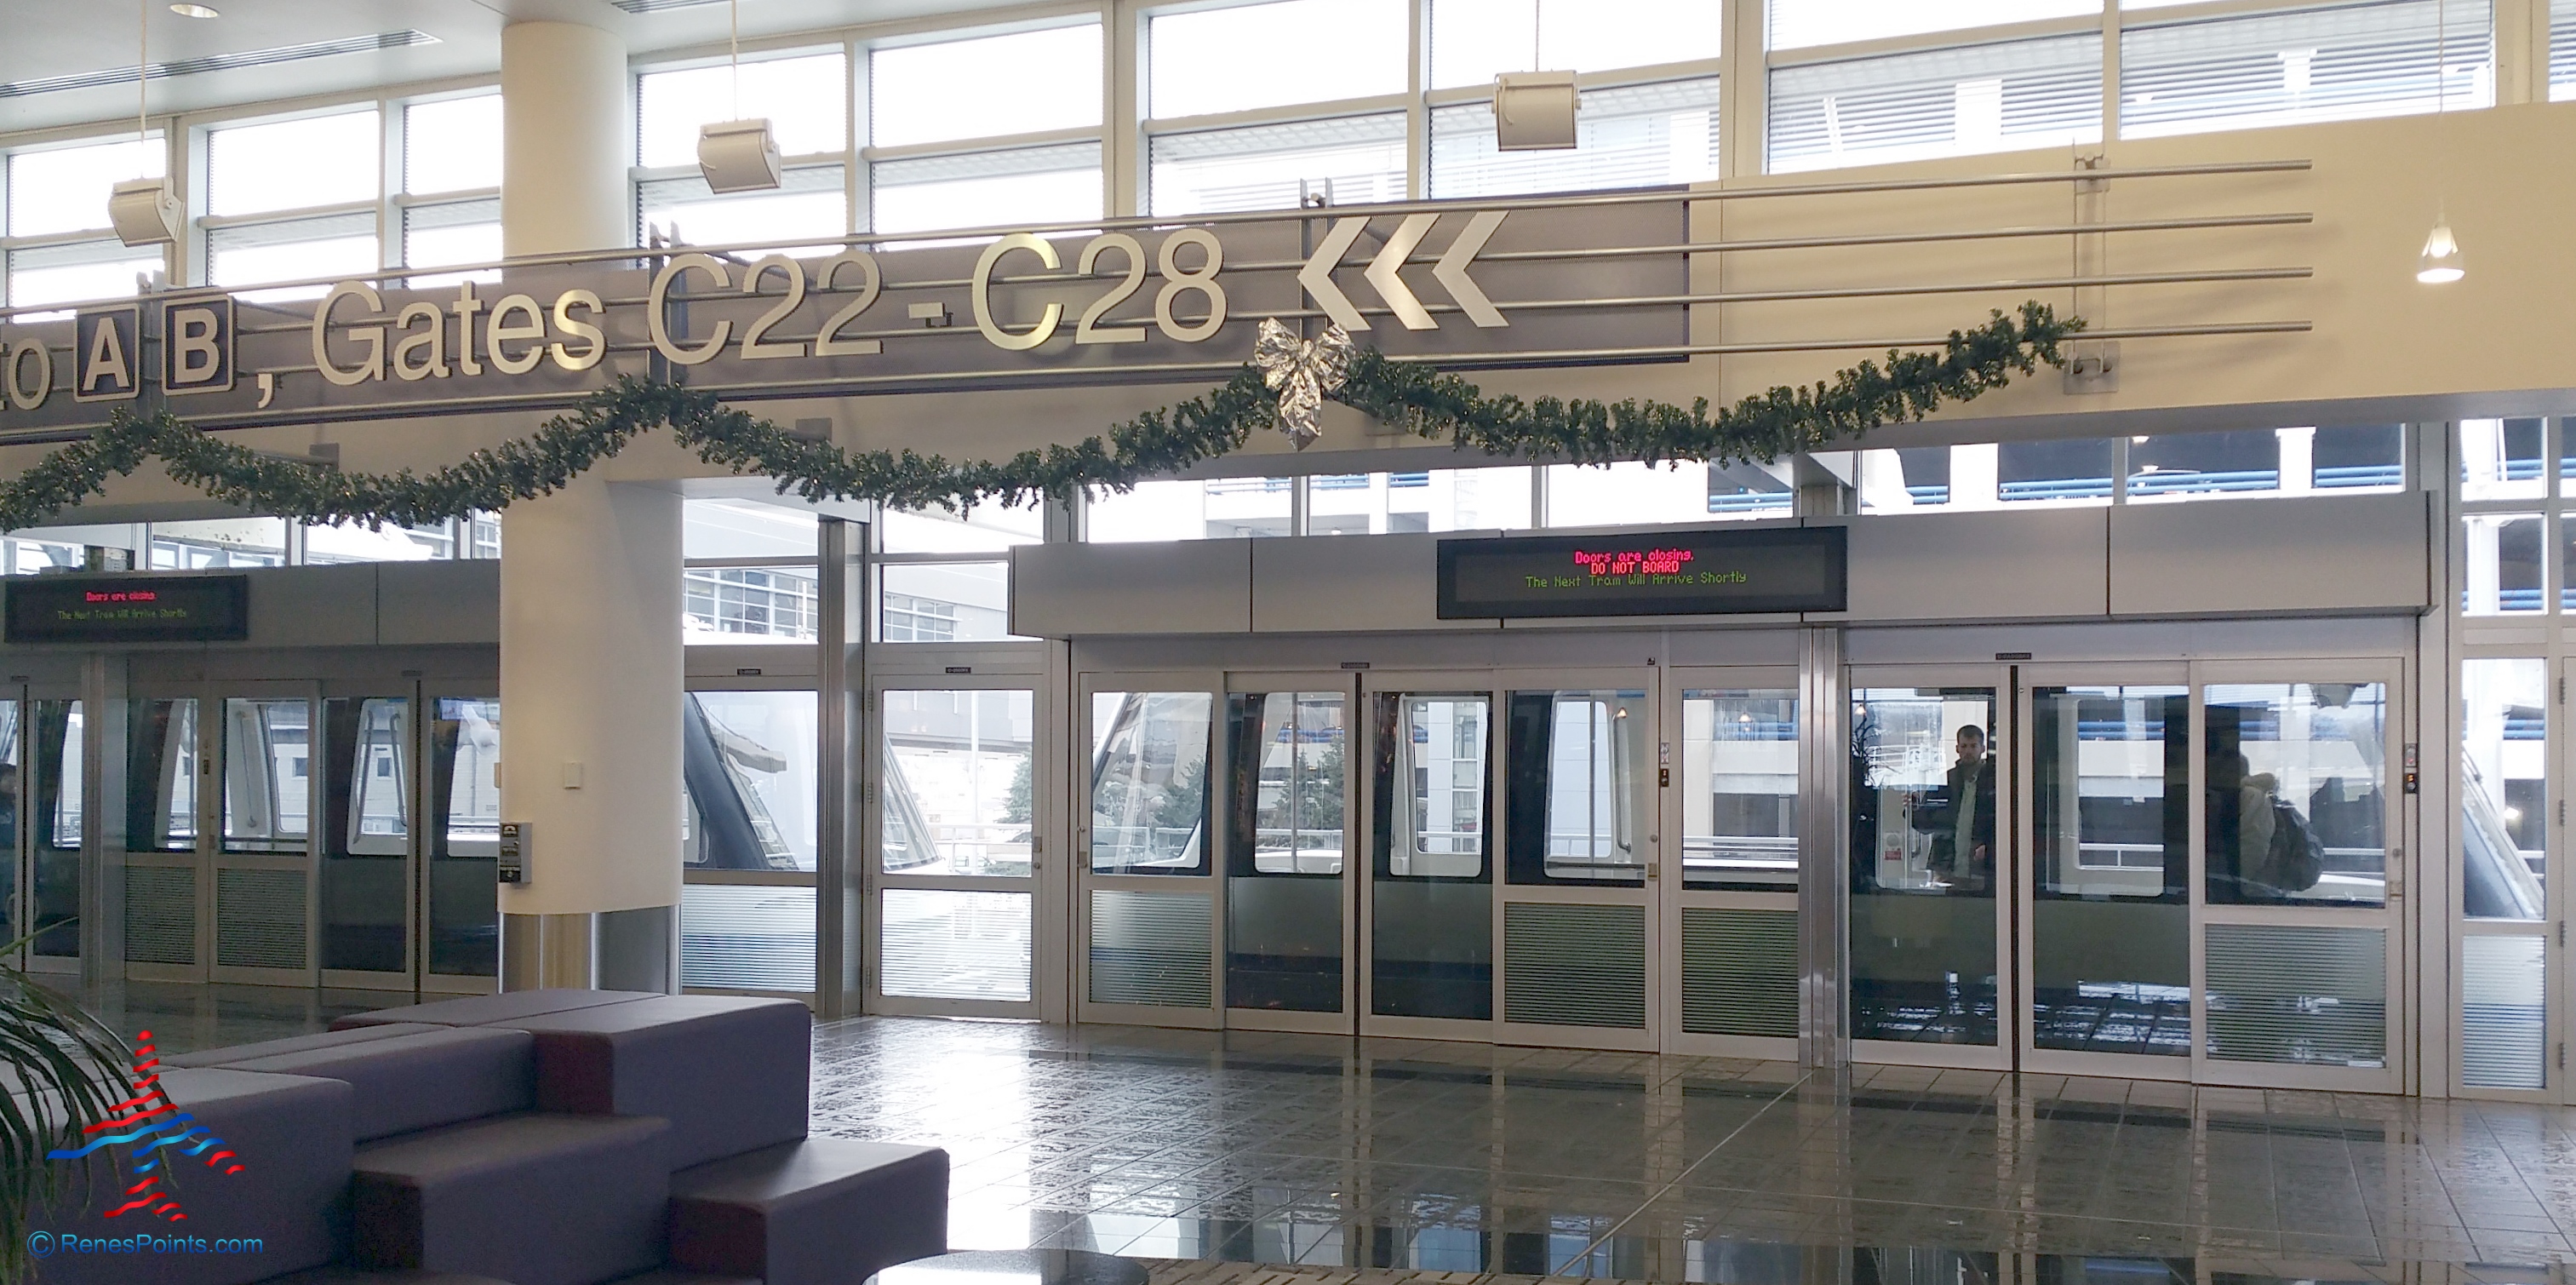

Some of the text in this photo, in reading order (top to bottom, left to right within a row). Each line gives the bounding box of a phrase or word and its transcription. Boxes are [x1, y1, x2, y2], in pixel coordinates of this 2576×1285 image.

[0, 337, 51, 410] o
[83, 316, 130, 392] A
[312, 279, 607, 387] Gates
[648, 252, 884, 365] C22
[907, 301, 945, 320] -
[972, 227, 1228, 351] C28
[1575, 551, 1611, 564] Doors
[1617, 552, 1642, 562] are
[1590, 560, 1680, 575] DO NOT BOARD
[1526, 571, 1747, 588] The Next Tram Will Arrive Shortly
